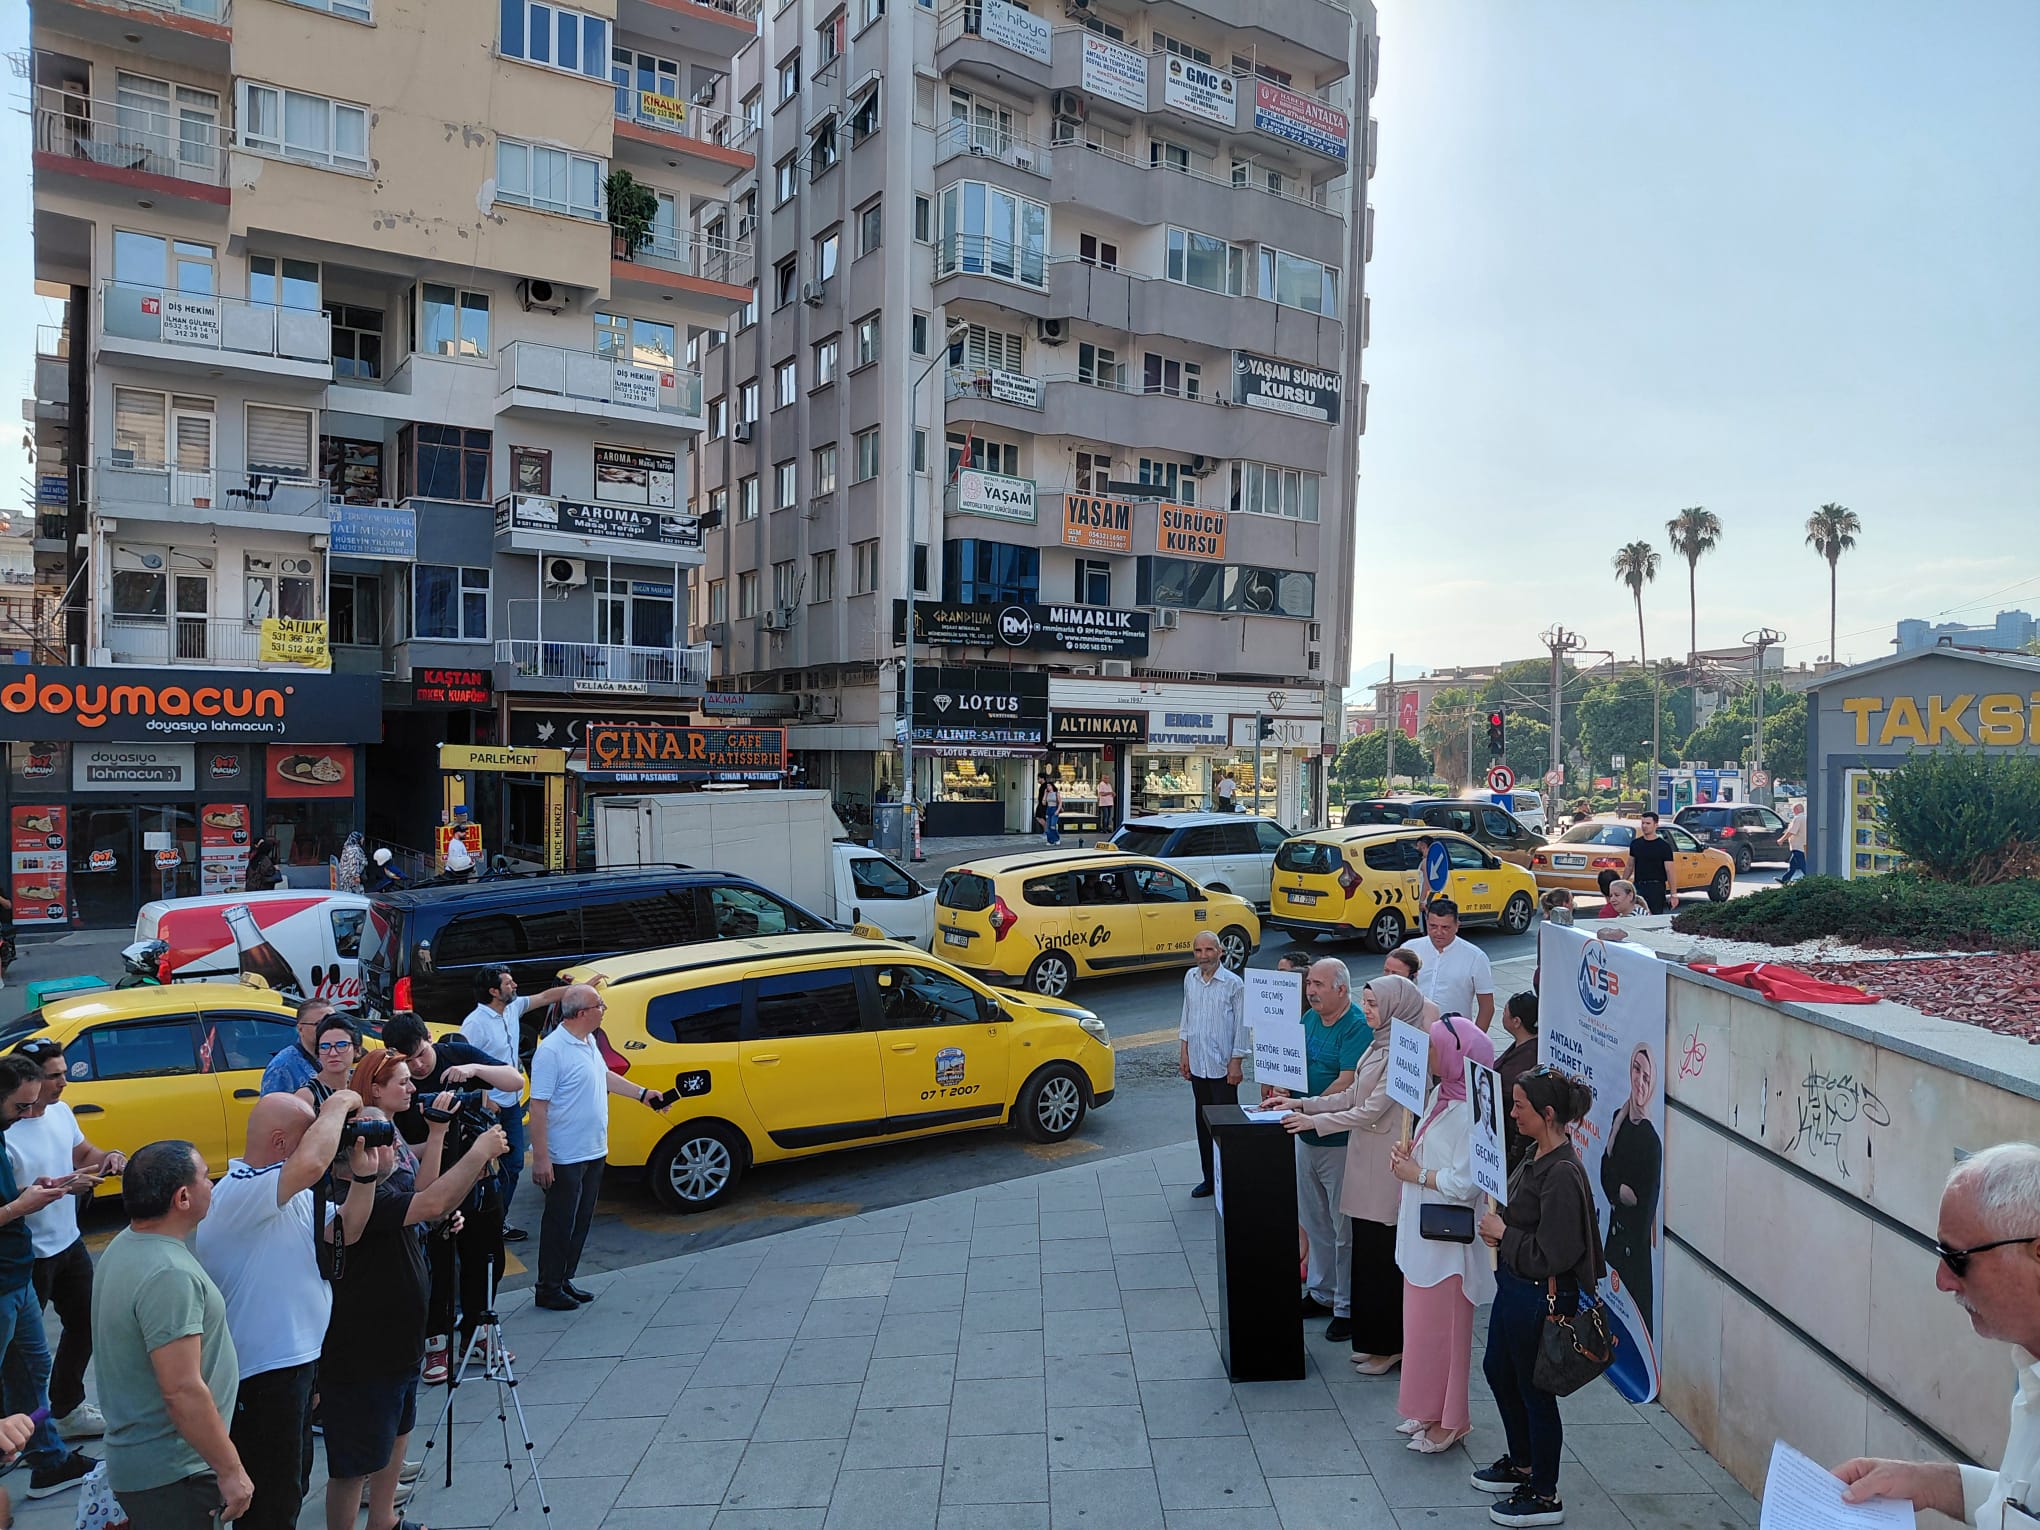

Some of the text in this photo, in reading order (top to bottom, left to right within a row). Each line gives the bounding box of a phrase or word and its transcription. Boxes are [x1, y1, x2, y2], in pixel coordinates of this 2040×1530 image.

[1007, 10, 1047, 38] hibya
[1187, 66, 1218, 90] GMC
[1305, 104, 1344, 129] ANTALYA
[168, 302, 214, 316] DİŞ HEKİMİ
[166, 315, 217, 329] İLHAN GÜLMEZ
[617, 369, 654, 381] DİŞ HEKİMİ
[1249, 359, 1341, 393] YAŞAM SÜRÜCÜ
[1260, 380, 1316, 405] KURSU
[603, 451, 632, 464] AROMA
[984, 486, 1032, 506] YAŞAM
[581, 506, 639, 523] AROMA
[1068, 496, 1130, 531] YAŞAM
[574, 519, 607, 531] Masaj
[610, 522, 645, 535] Terapi
[1163, 509, 1224, 535] SÜRÜCÜ
[1167, 531, 1217, 555] KURSU
[278, 619, 323, 635] SATILIK
[1003, 616, 1029, 635] RM
[271, 632, 286, 641] 531
[271, 642, 285, 651] 531
[288, 644, 303, 653] 512
[304, 646, 314, 654] 44
[424, 670, 482, 688] KAŞTAN
[1, 673, 285, 727] doymacun
[417, 689, 445, 701] ERKEK
[958, 694, 1019, 712] LOTUS
[211, 719, 273, 733] lahmacun
[1060, 716, 1139, 734] ALTINKAYA
[1164, 713, 1214, 728] EMRE
[728, 735, 762, 748] CAFE
[1149, 733, 1227, 745] KUYUMCULUK
[595, 731, 706, 767] ÇINAR
[943, 749, 968, 757] LOTUS
[969, 749, 1011, 758] JEWELLERY
[470, 753, 538, 766] PARLEMENT
[92, 768, 162, 780] lahmacun
[616, 772, 637, 781] ÇINAR
[720, 772, 740, 781] ÇINAR
[1034, 925, 1112, 950] Yandex Go
[1174, 942, 1191, 950] 4655
[1261, 990, 1284, 1001] GEÇMİŞ
[1264, 1006, 1284, 1015] OLSUN
[1549, 1028, 1584, 1056] ANTALYA
[1256, 1043, 1300, 1058] SEKTÖRE ENGEL
[1256, 1058, 1302, 1075] GELİŞİME DARBE
[1549, 1046, 1593, 1081] TİCARET VE
[920, 1085, 980, 1101] 07 T 2007
[1475, 1142, 1500, 1171] GEÇMİŞ
[1477, 1170, 1500, 1195] OLSUN
